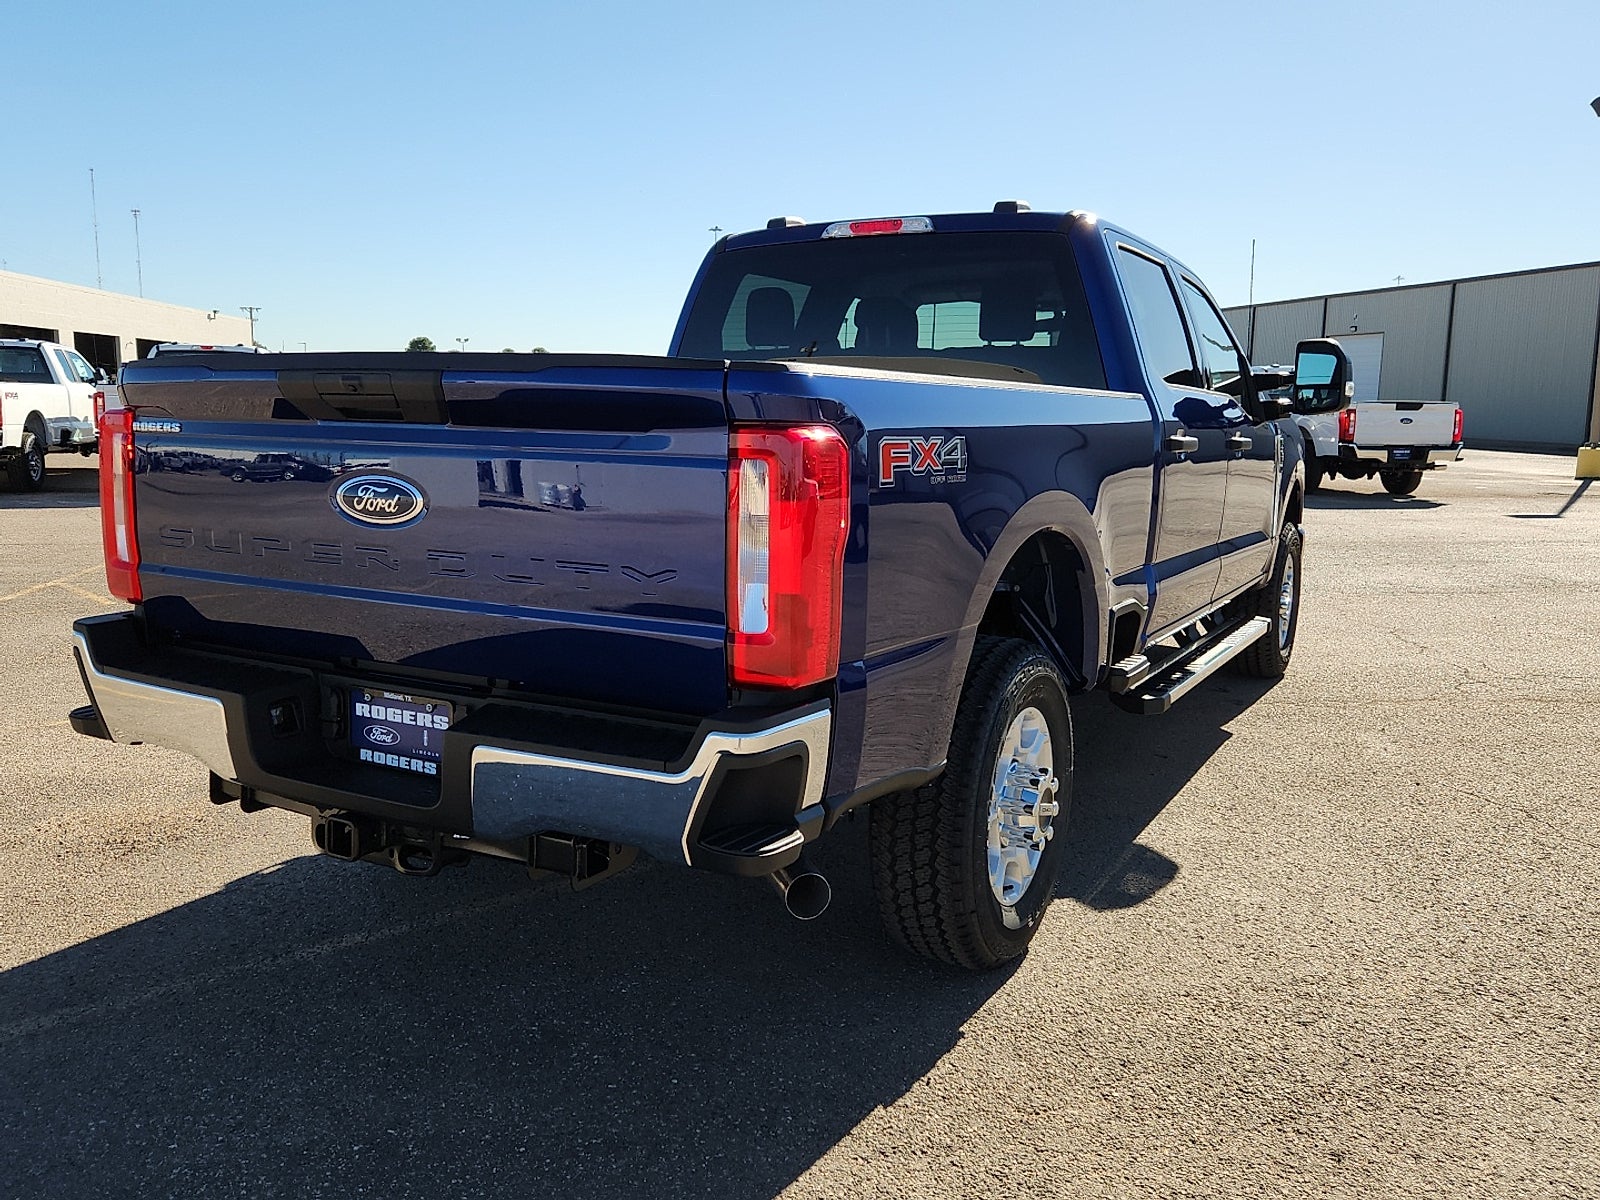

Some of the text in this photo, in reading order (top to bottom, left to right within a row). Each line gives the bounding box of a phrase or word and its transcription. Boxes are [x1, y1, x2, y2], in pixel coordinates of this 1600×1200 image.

[132, 421, 182, 433] ROGERS
[878, 436, 967, 487] FX4
[353, 484, 400, 513] Ford
[158, 526, 679, 597] SUPER DUTY
[355, 702, 449, 730] ROGERS
[369, 726, 394, 744] Ford
[360, 748, 437, 775] ROGERS
